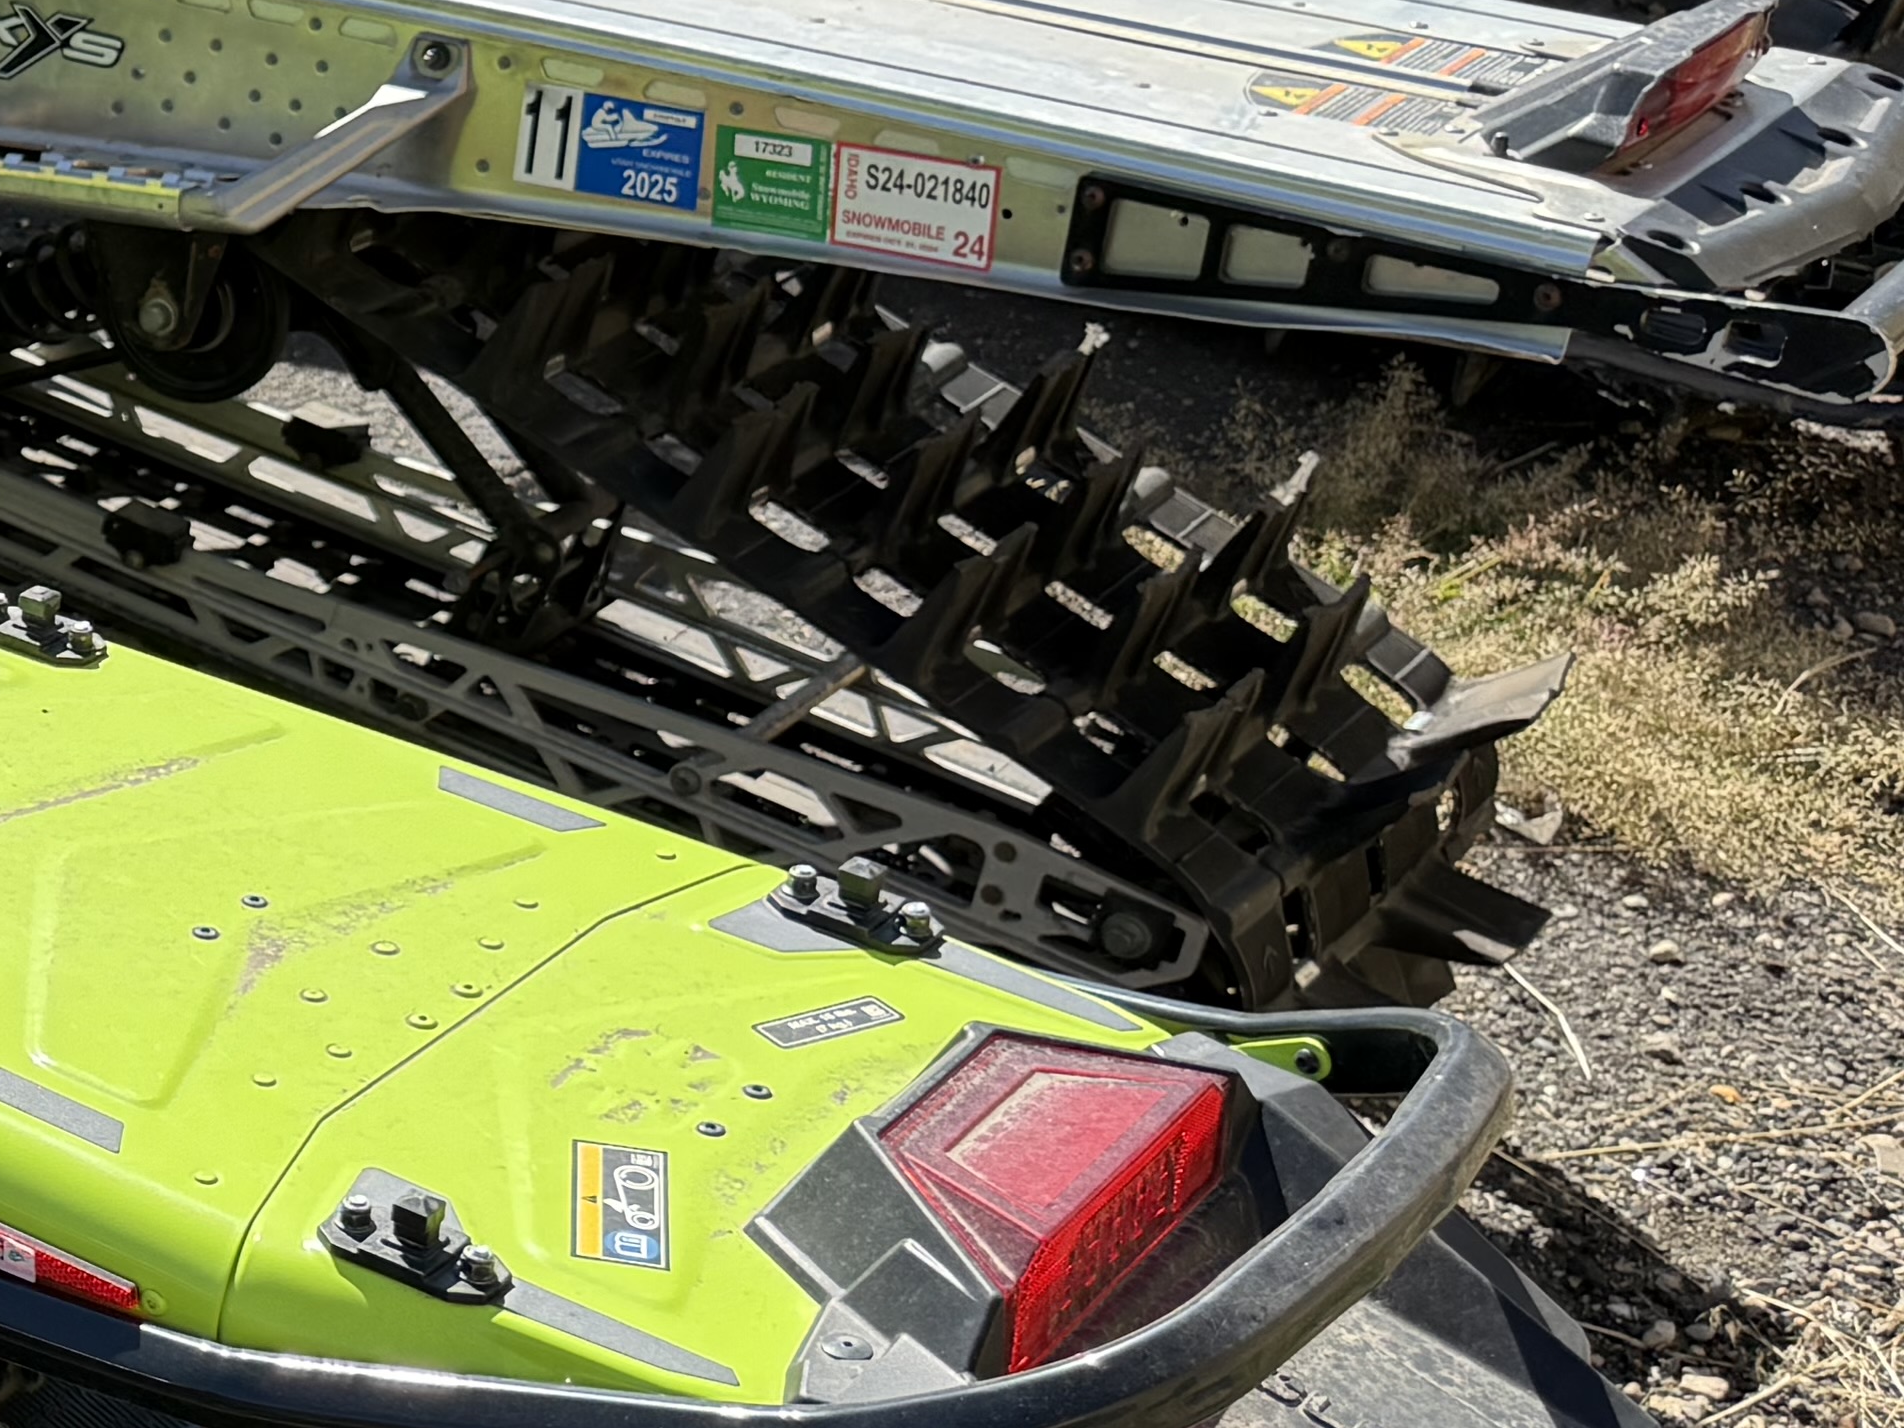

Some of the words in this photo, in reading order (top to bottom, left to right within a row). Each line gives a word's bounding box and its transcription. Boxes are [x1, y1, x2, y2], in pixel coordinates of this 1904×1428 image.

[524, 89, 574, 181] 11
[753, 139, 794, 158] 17323
[620, 169, 679, 205] 2025
[844, 152, 861, 201] IDAHO
[865, 163, 991, 210] S24-021840
[750, 191, 811, 211] WYOMING
[842, 209, 945, 242] SNOWMOBILE
[951, 230, 985, 262] 24
